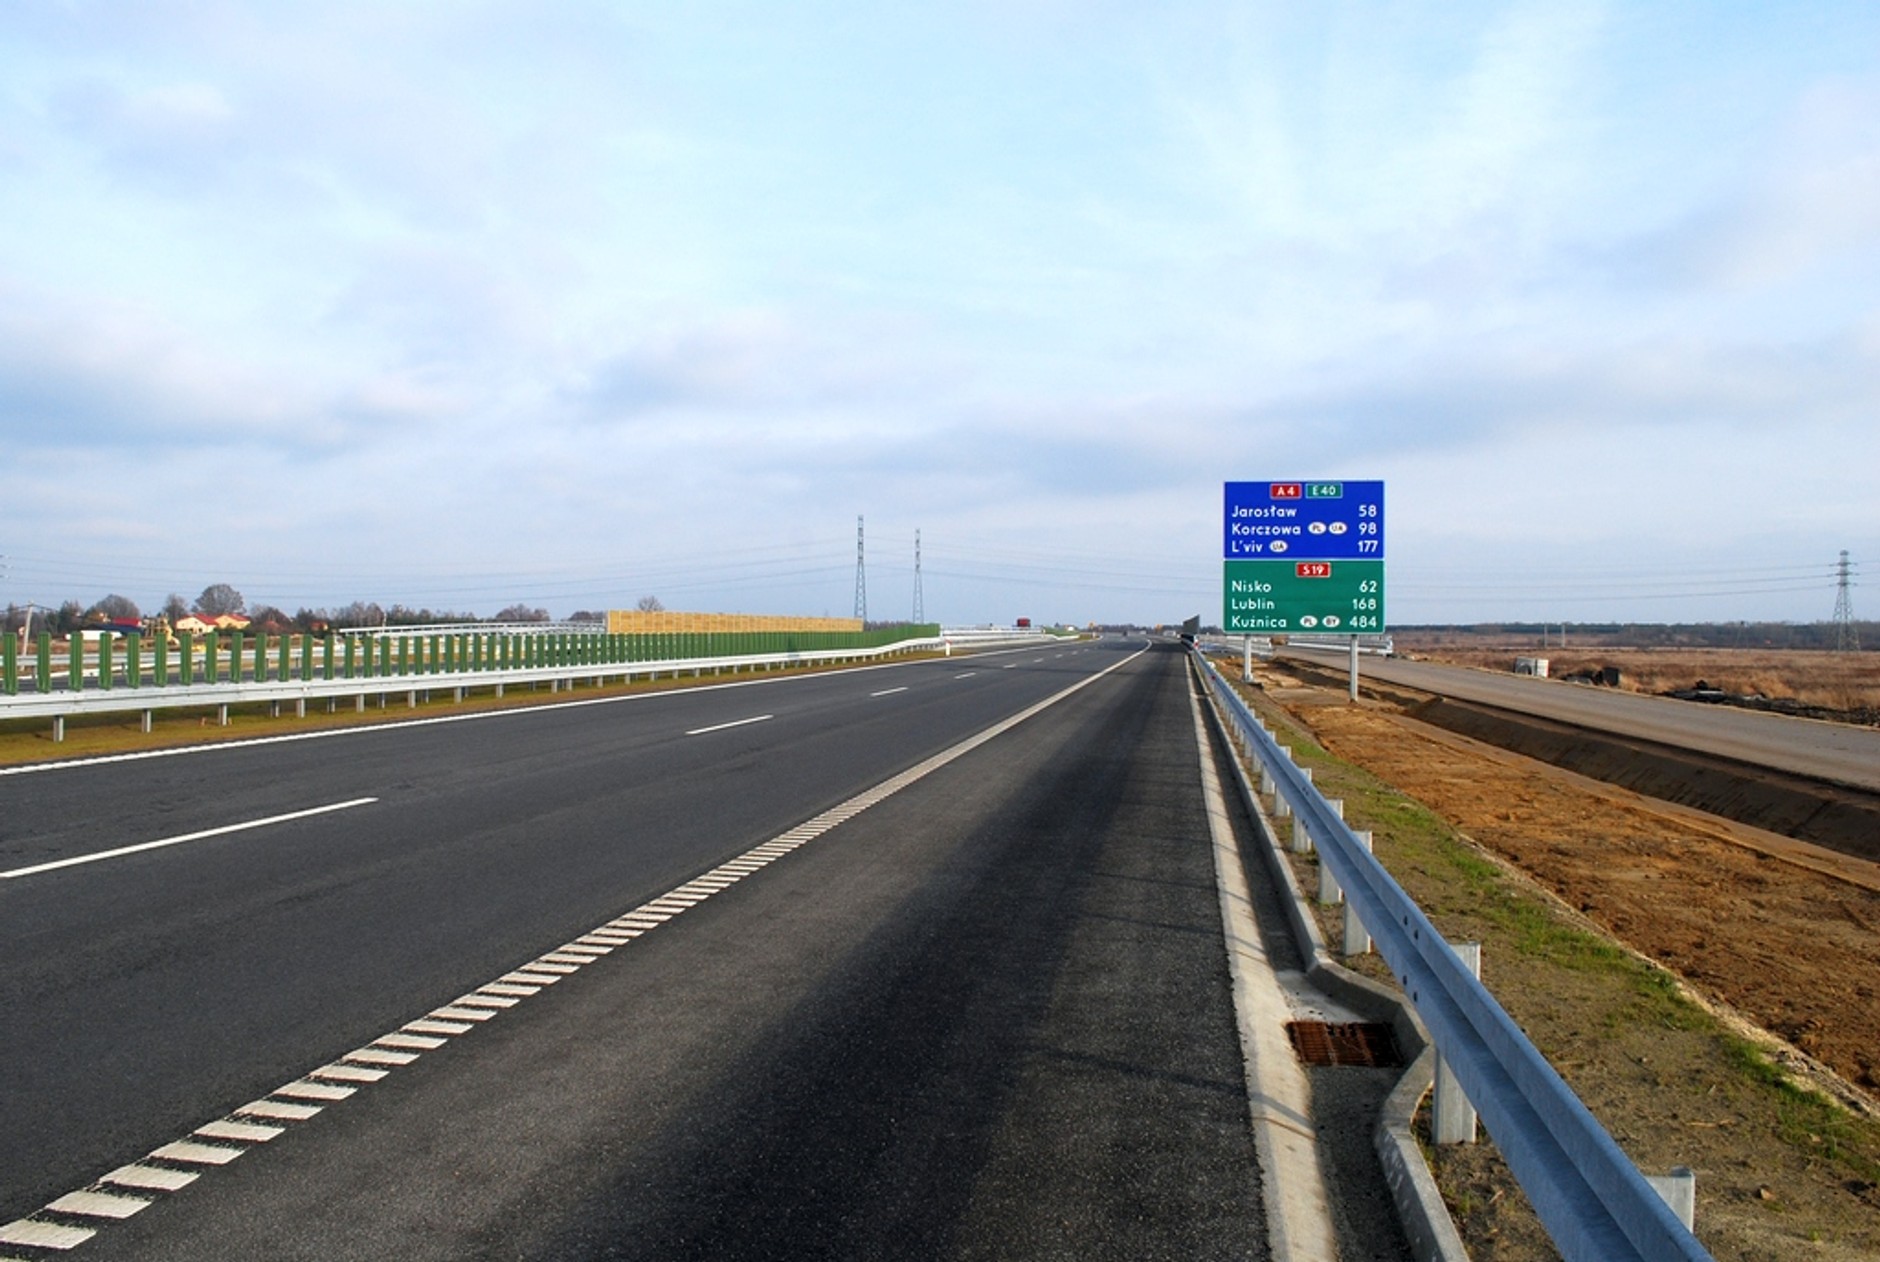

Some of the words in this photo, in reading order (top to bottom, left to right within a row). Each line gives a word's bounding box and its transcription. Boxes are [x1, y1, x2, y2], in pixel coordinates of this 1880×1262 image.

[1232, 505, 1296, 518] Jarosław
[1359, 505, 1376, 516] 58
[1232, 523, 1301, 535] Korczowa
[1359, 523, 1376, 534] 98
[1358, 541, 1378, 552] 177
[1232, 581, 1271, 593] Nisko
[1359, 581, 1376, 592] 62
[1232, 599, 1274, 609] Lublin
[1352, 599, 1376, 610] 168
[1232, 616, 1287, 628] Kuźnica
[1350, 616, 1376, 627] 484
